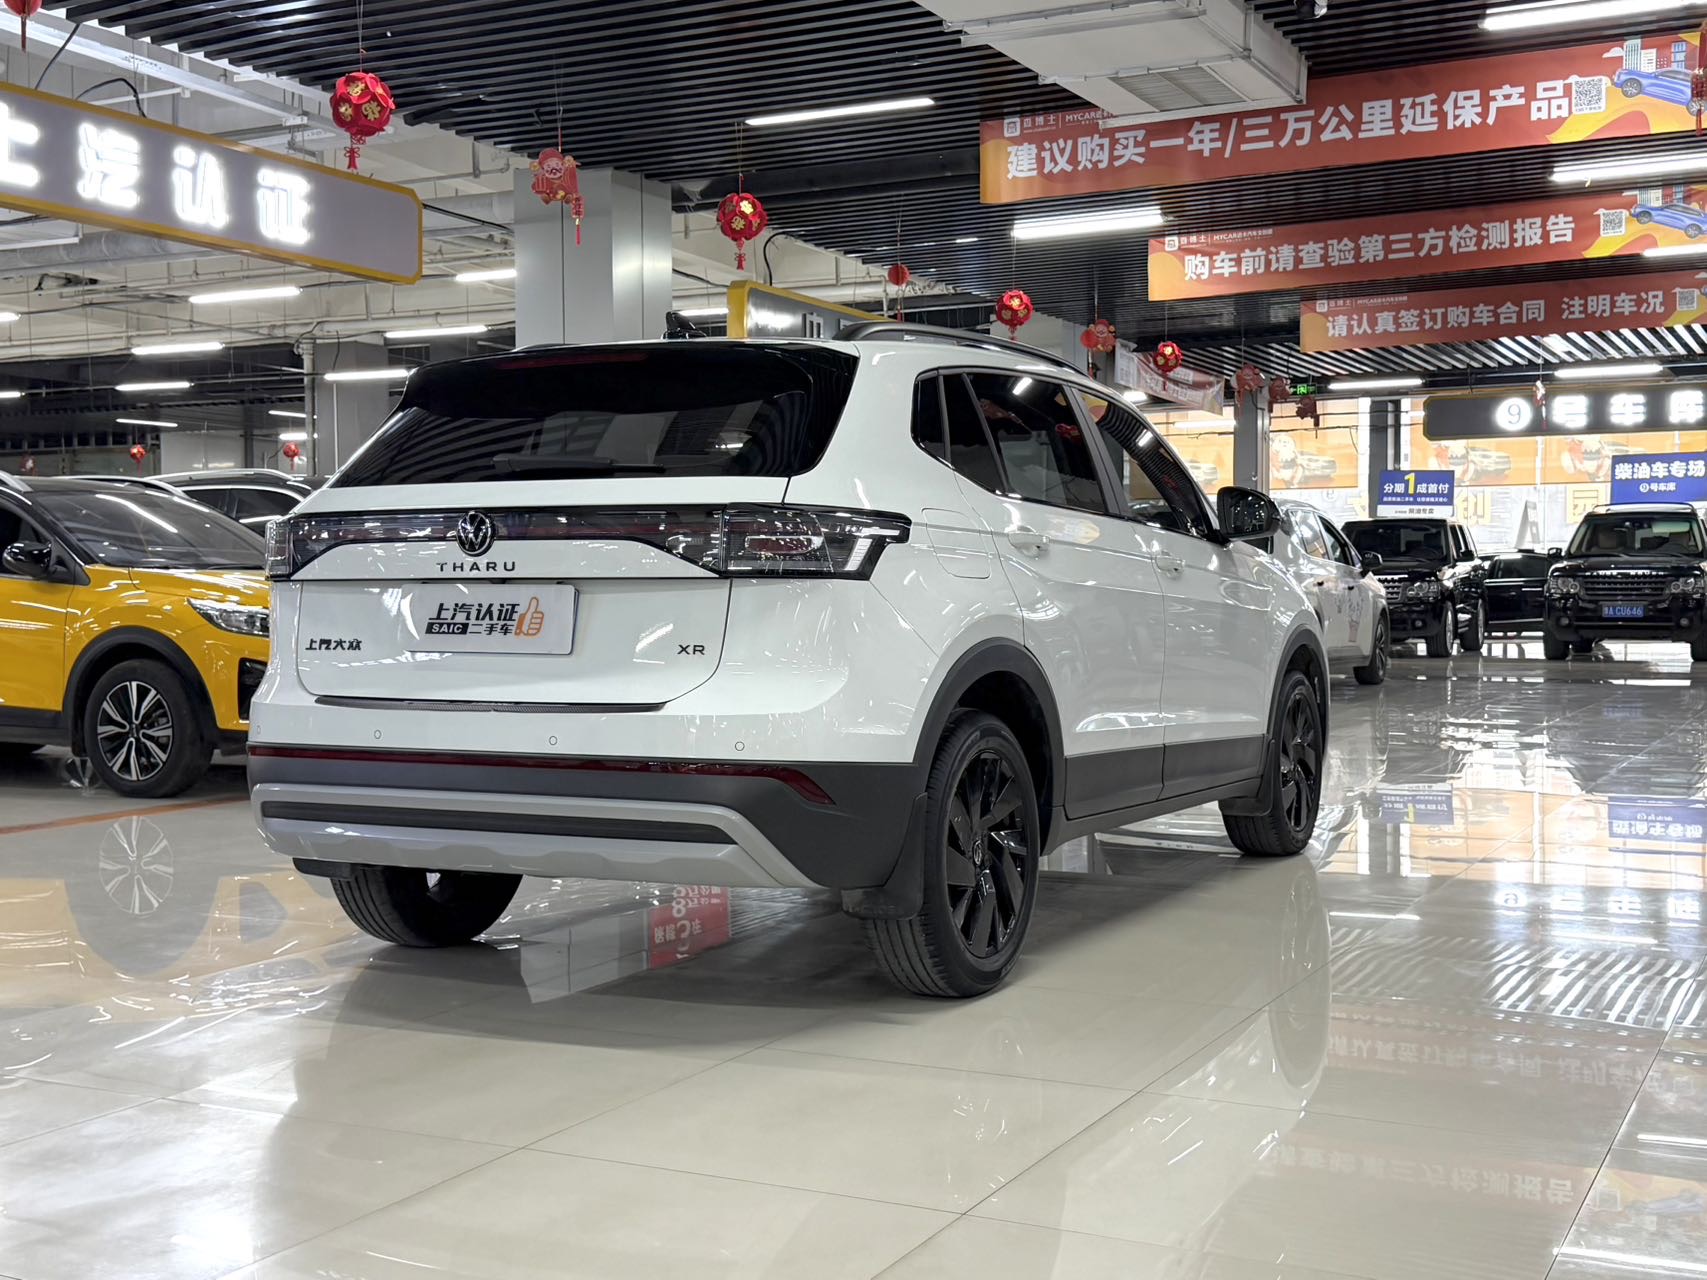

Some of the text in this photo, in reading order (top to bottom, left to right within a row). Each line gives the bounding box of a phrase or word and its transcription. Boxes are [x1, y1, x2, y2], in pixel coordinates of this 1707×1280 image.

[1006, 79, 1569, 180] 建议购买一年/三万公里延保产品
[1184, 214, 1575, 281] 购车前请查验第三方检测报告
[1326, 290, 1665, 338] 请认真签订购车合同 注明车况
[1614, 459, 1706, 481] 柴油车专场
[436, 560, 516, 573] THARU
[428, 602, 520, 621] 上汽认证
[431, 622, 516, 636] SAIC 二手车
[304, 638, 362, 651] 上汽大众
[677, 643, 706, 656] XR
